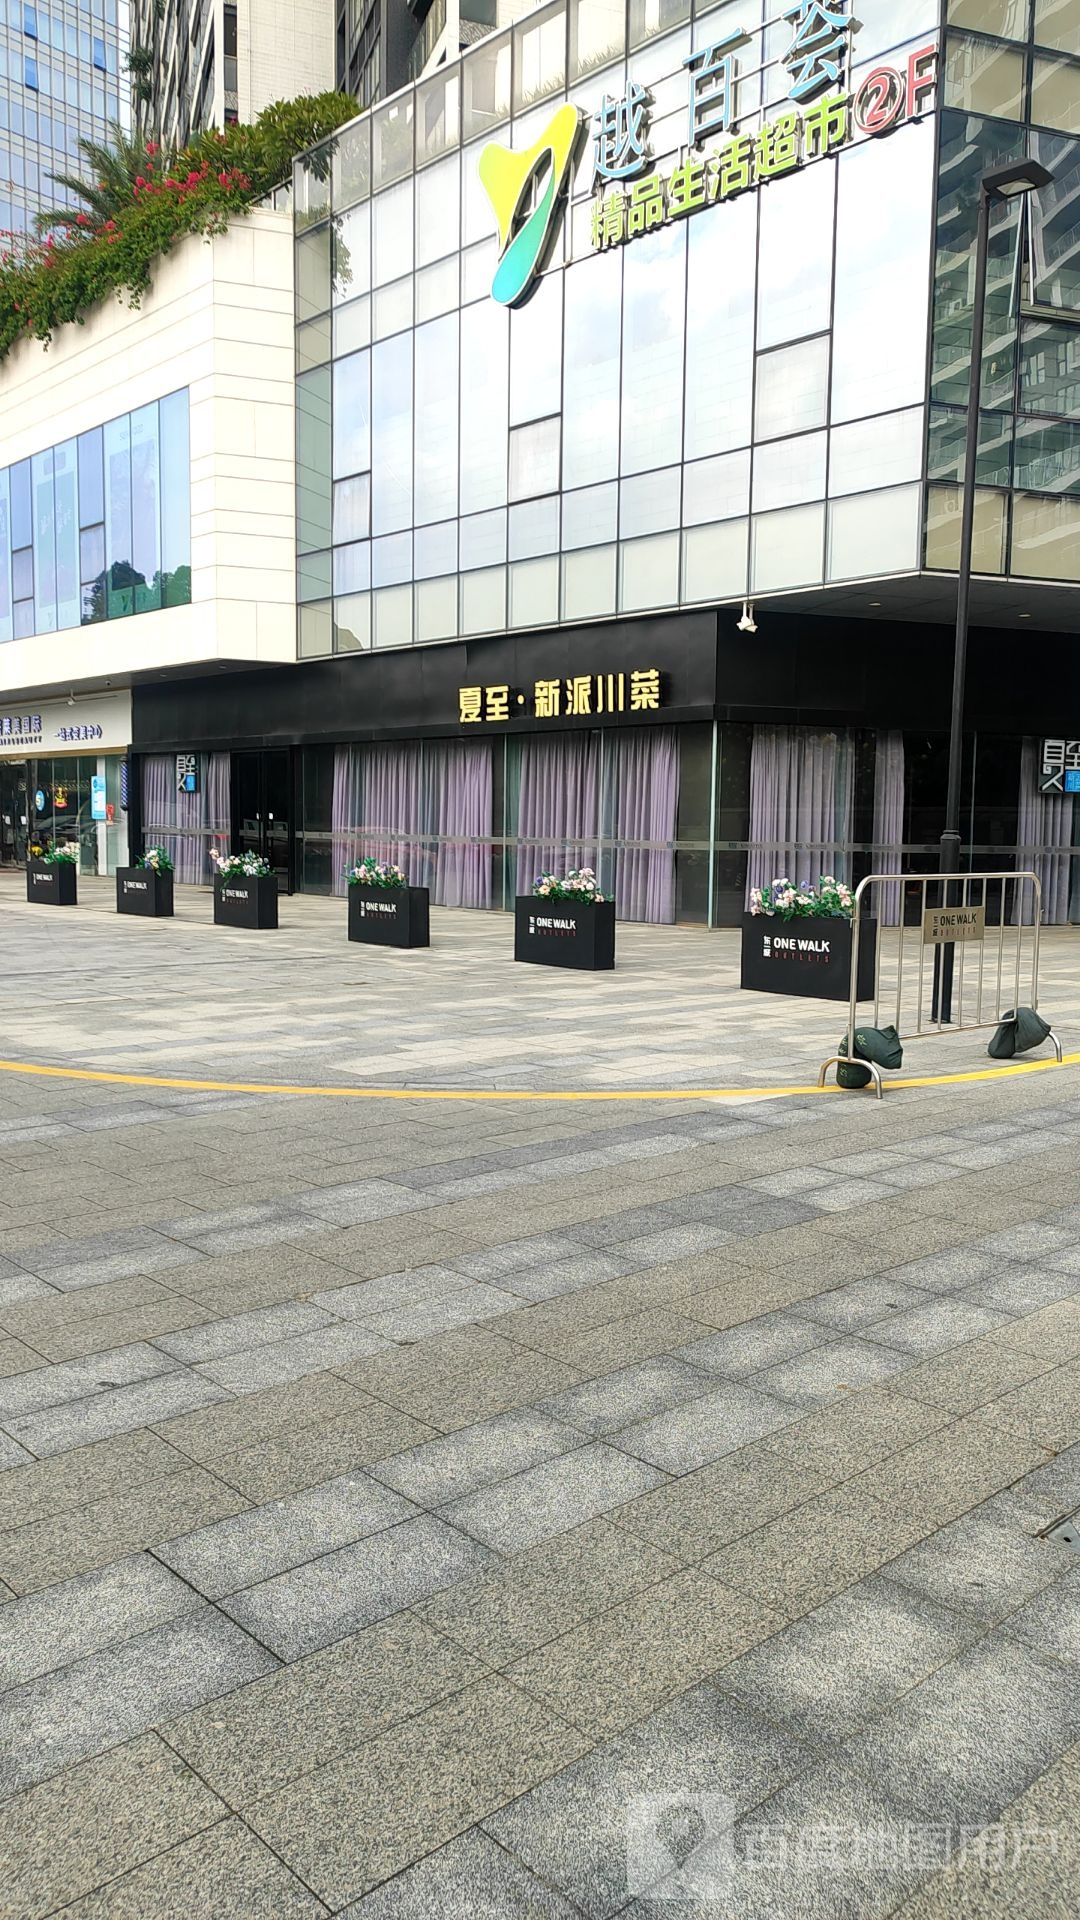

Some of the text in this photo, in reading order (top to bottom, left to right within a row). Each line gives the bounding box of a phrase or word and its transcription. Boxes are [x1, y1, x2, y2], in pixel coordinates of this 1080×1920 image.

[591, 92, 848, 248] 精品生活超市
[366, 902, 378, 911] ONE
[379, 903, 396, 913] WALK
[537, 917, 552, 928] ONE
[553, 919, 576, 930] WALK
[940, 915, 955, 926] ONE
[957, 913, 977, 925] WALK
[773, 937, 830, 953] ONE WALK
